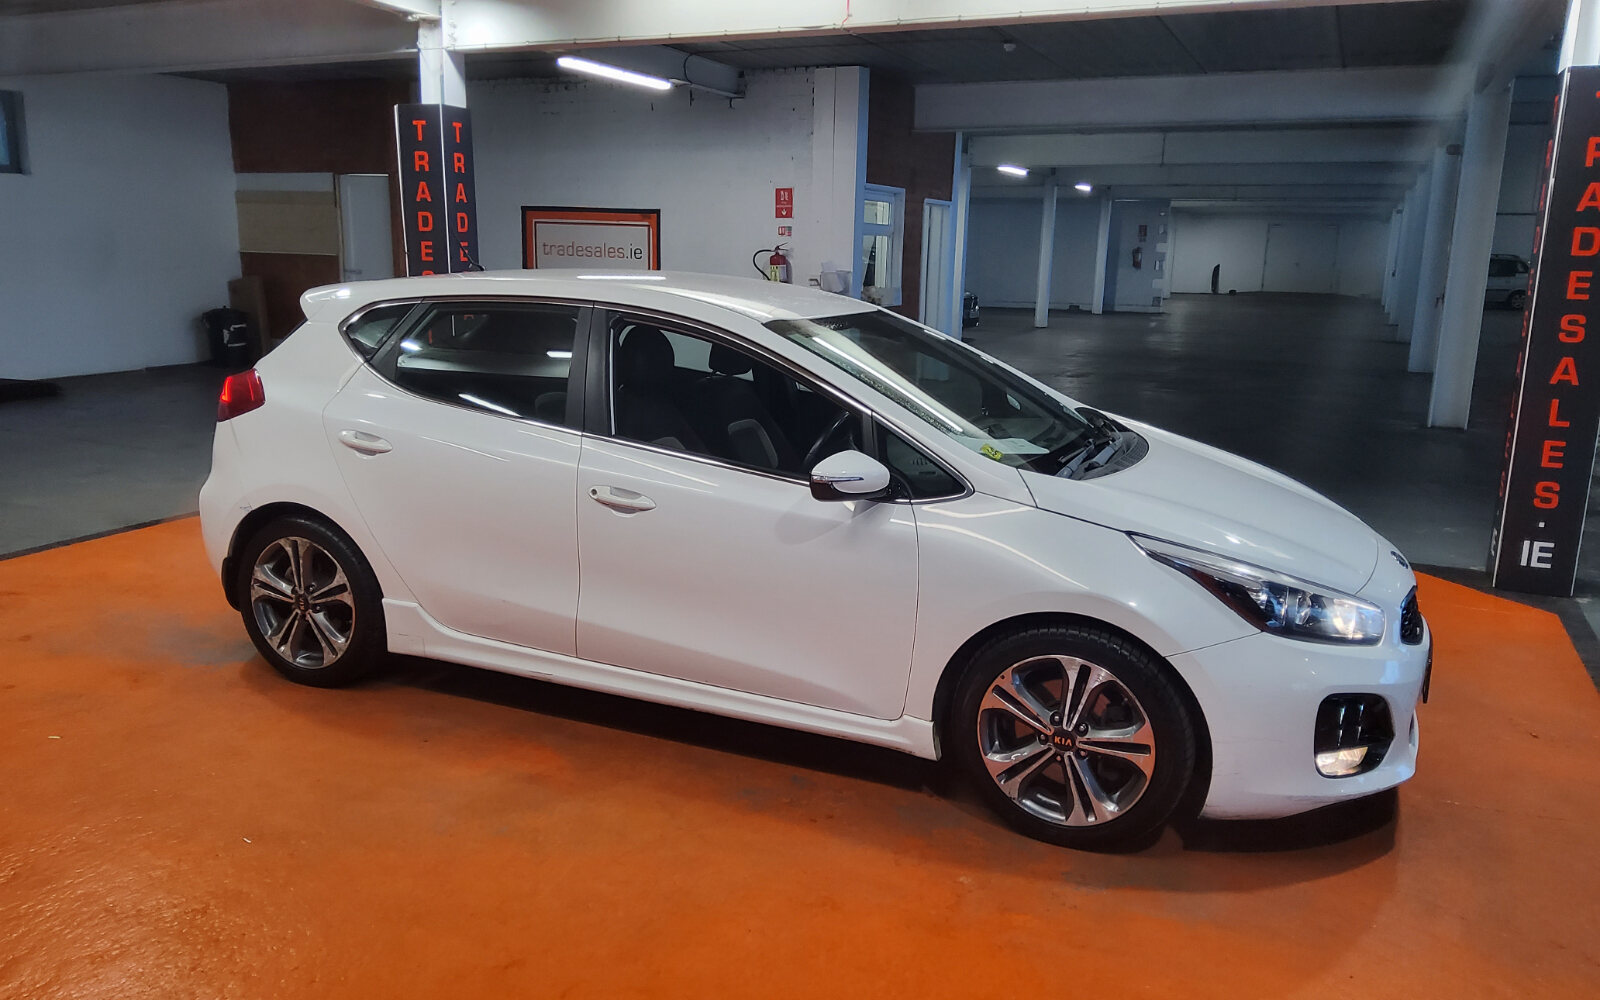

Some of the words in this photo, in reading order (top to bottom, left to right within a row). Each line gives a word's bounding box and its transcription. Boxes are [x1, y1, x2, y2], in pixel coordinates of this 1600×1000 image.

[412, 119, 434, 276] TRADE
[542, 240, 643, 260] tradesales.ie
[1054, 735, 1072, 746] KIA
